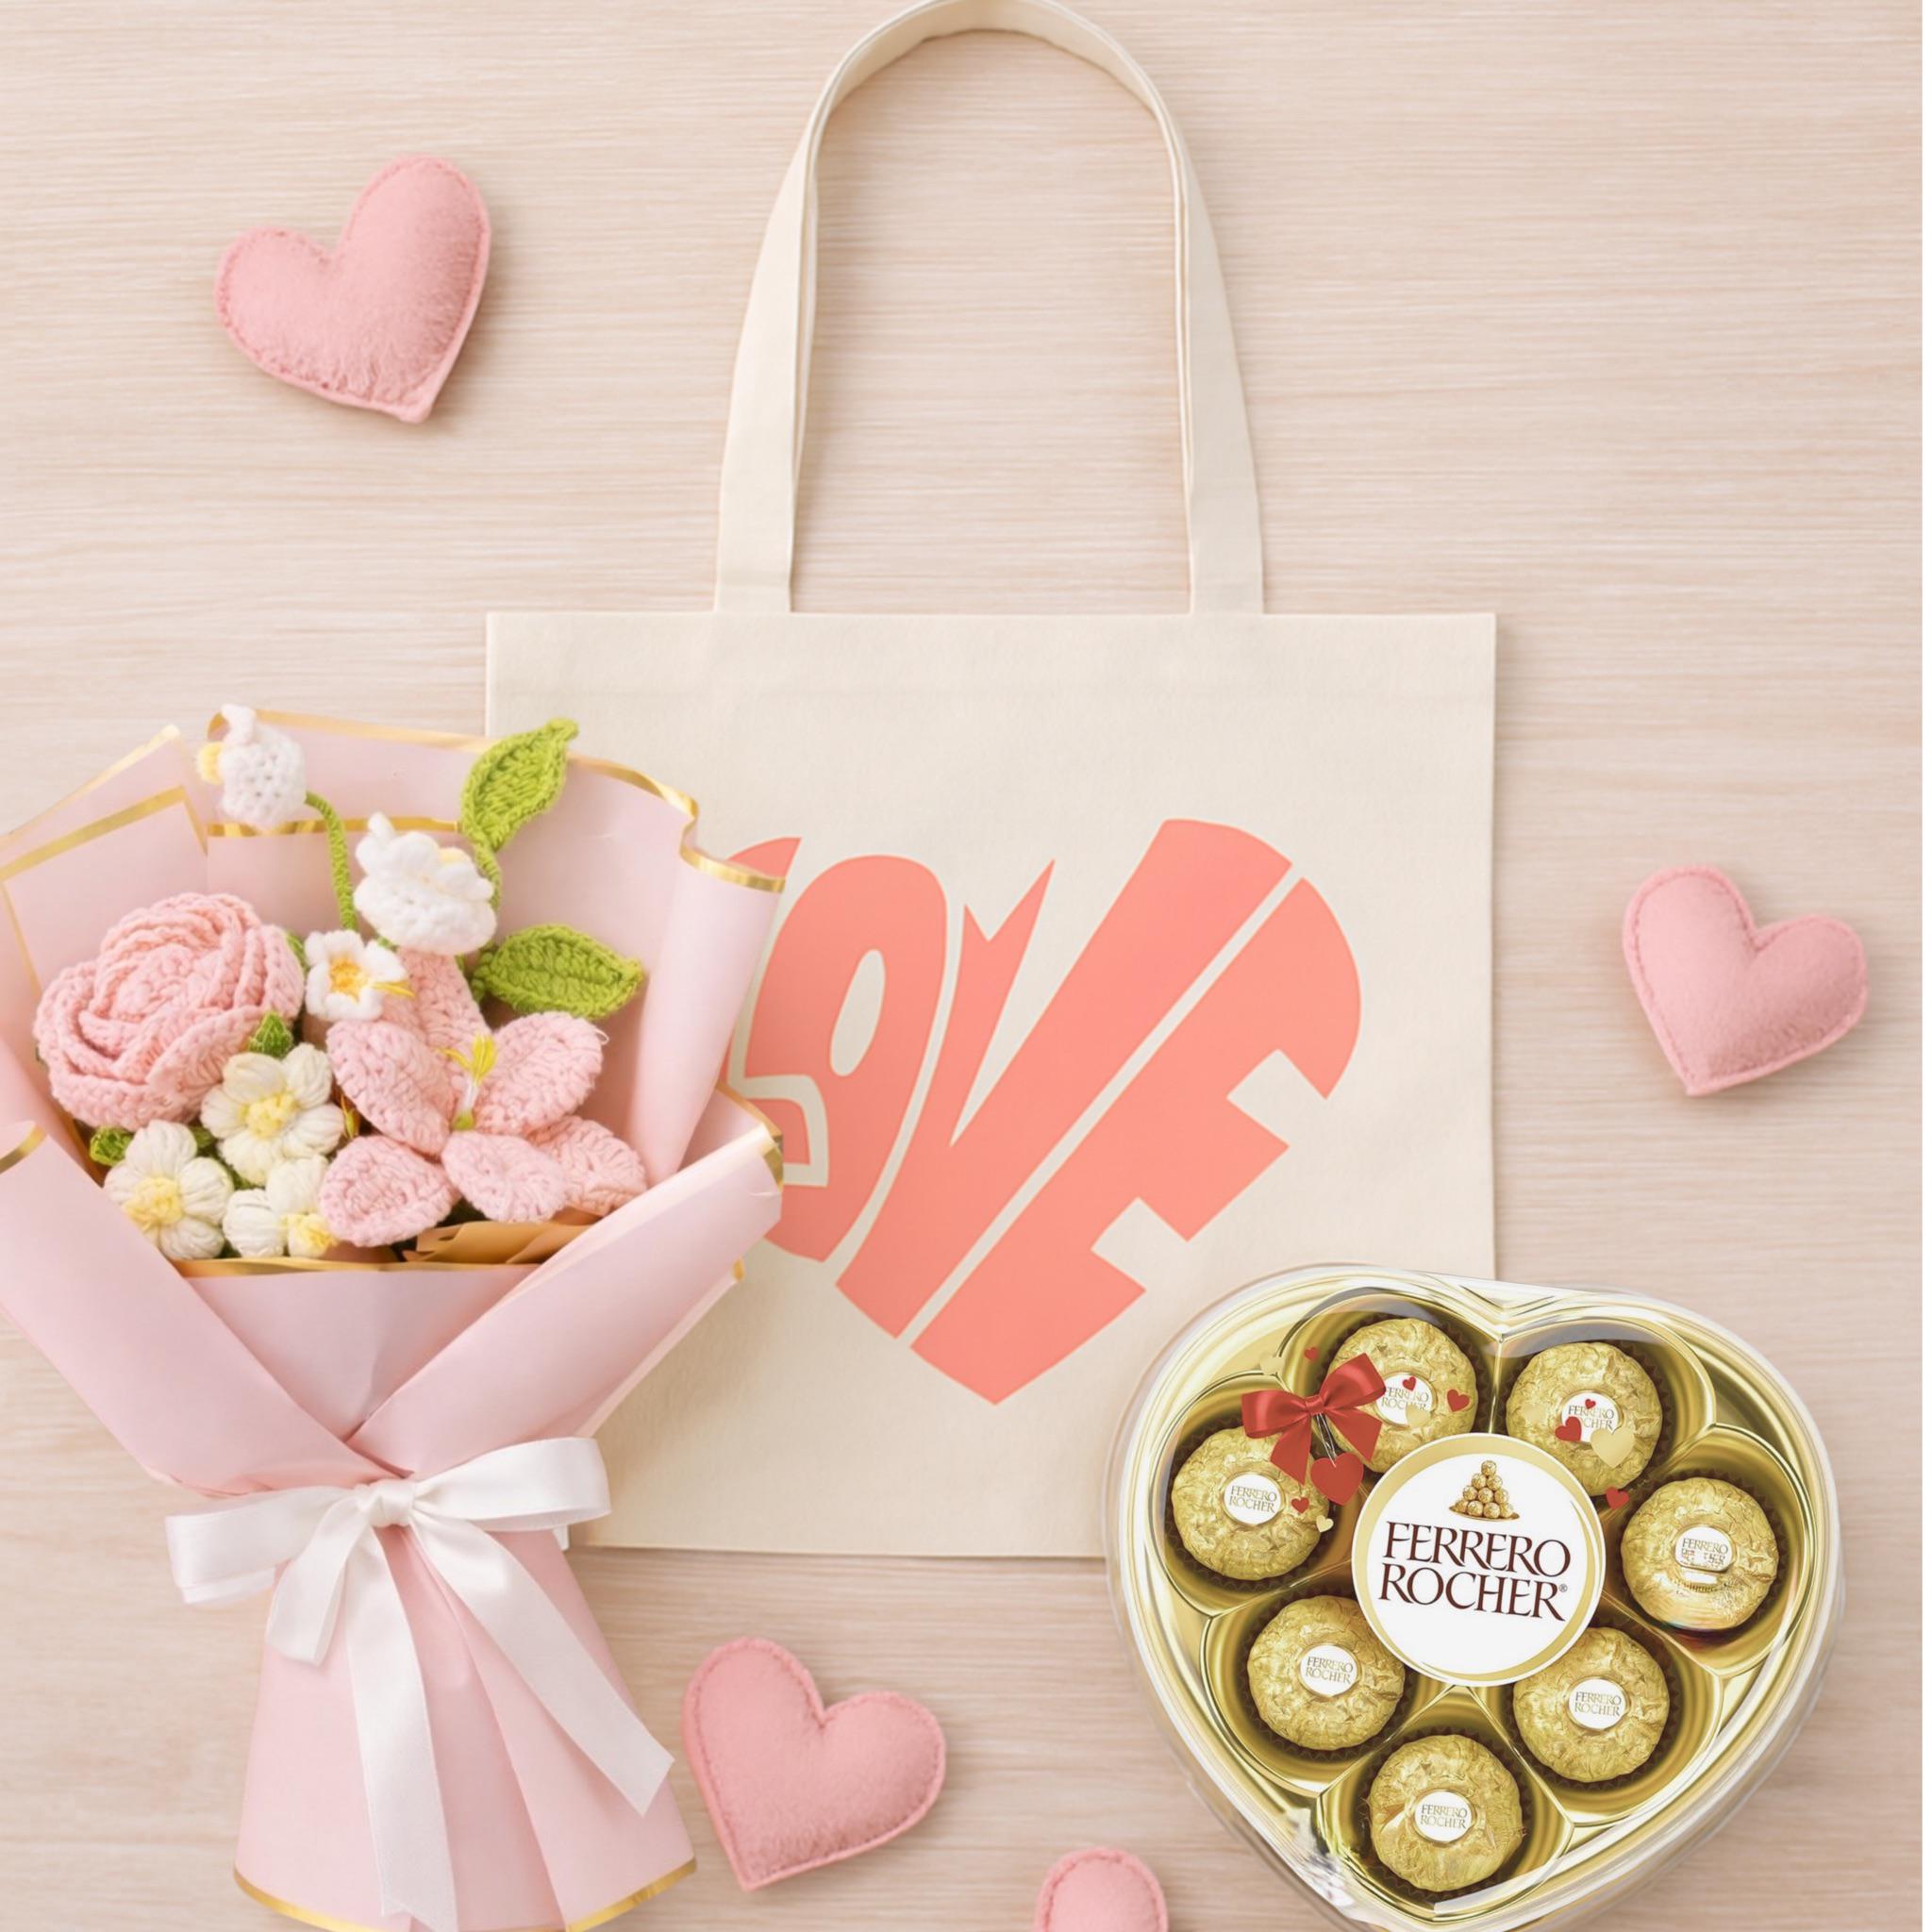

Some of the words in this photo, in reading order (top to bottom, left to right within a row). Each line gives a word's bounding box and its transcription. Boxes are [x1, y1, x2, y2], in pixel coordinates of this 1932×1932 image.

[716, 818, 1361, 1406] OVE
[1230, 1485, 1277, 1502] FERRERO
[1229, 1495, 1276, 1514] ROCHER
[1383, 1521, 1572, 1577] FERRERO
[1682, 1538, 1728, 1555] FERRERO
[1307, 1656, 1354, 1674] FERRERO
[1306, 1667, 1352, 1685] ROCHER
[1575, 1691, 1622, 1707] FERRERO
[1574, 1702, 1621, 1717] ROCHER
[1421, 1804, 1468, 1819] FERRERO
[1420, 1814, 1467, 1830] ROCHER
